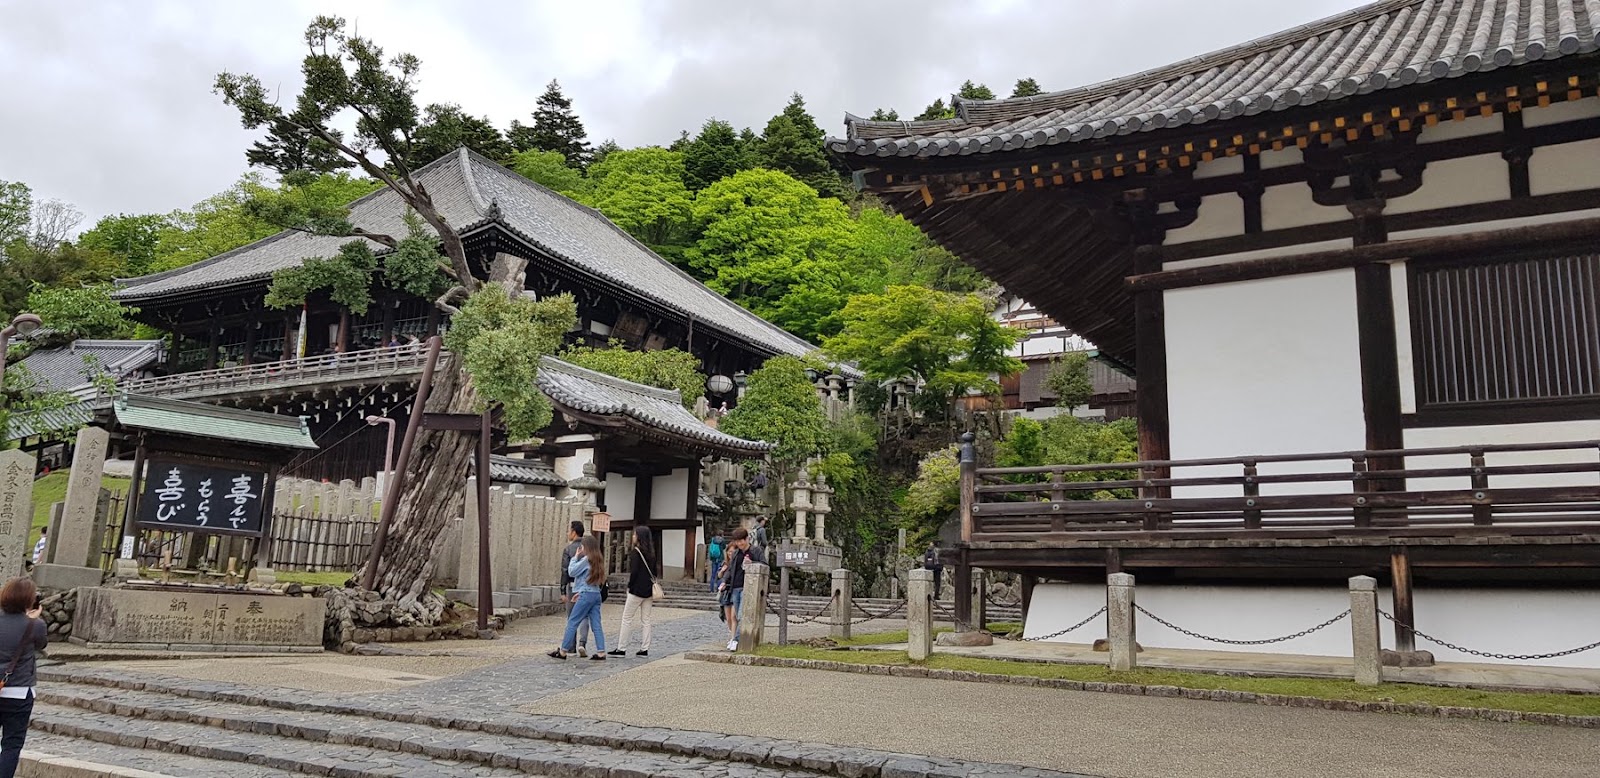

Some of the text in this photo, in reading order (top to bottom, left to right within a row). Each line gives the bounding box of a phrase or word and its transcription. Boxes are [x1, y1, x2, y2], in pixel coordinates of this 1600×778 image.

[155, 467, 185, 521] 喜び
[196, 478, 213, 526] もらう
[224, 474, 257, 529] 喜んで
[217, 604, 229, 632] 二月堂
[246, 601, 263, 616] 奉
